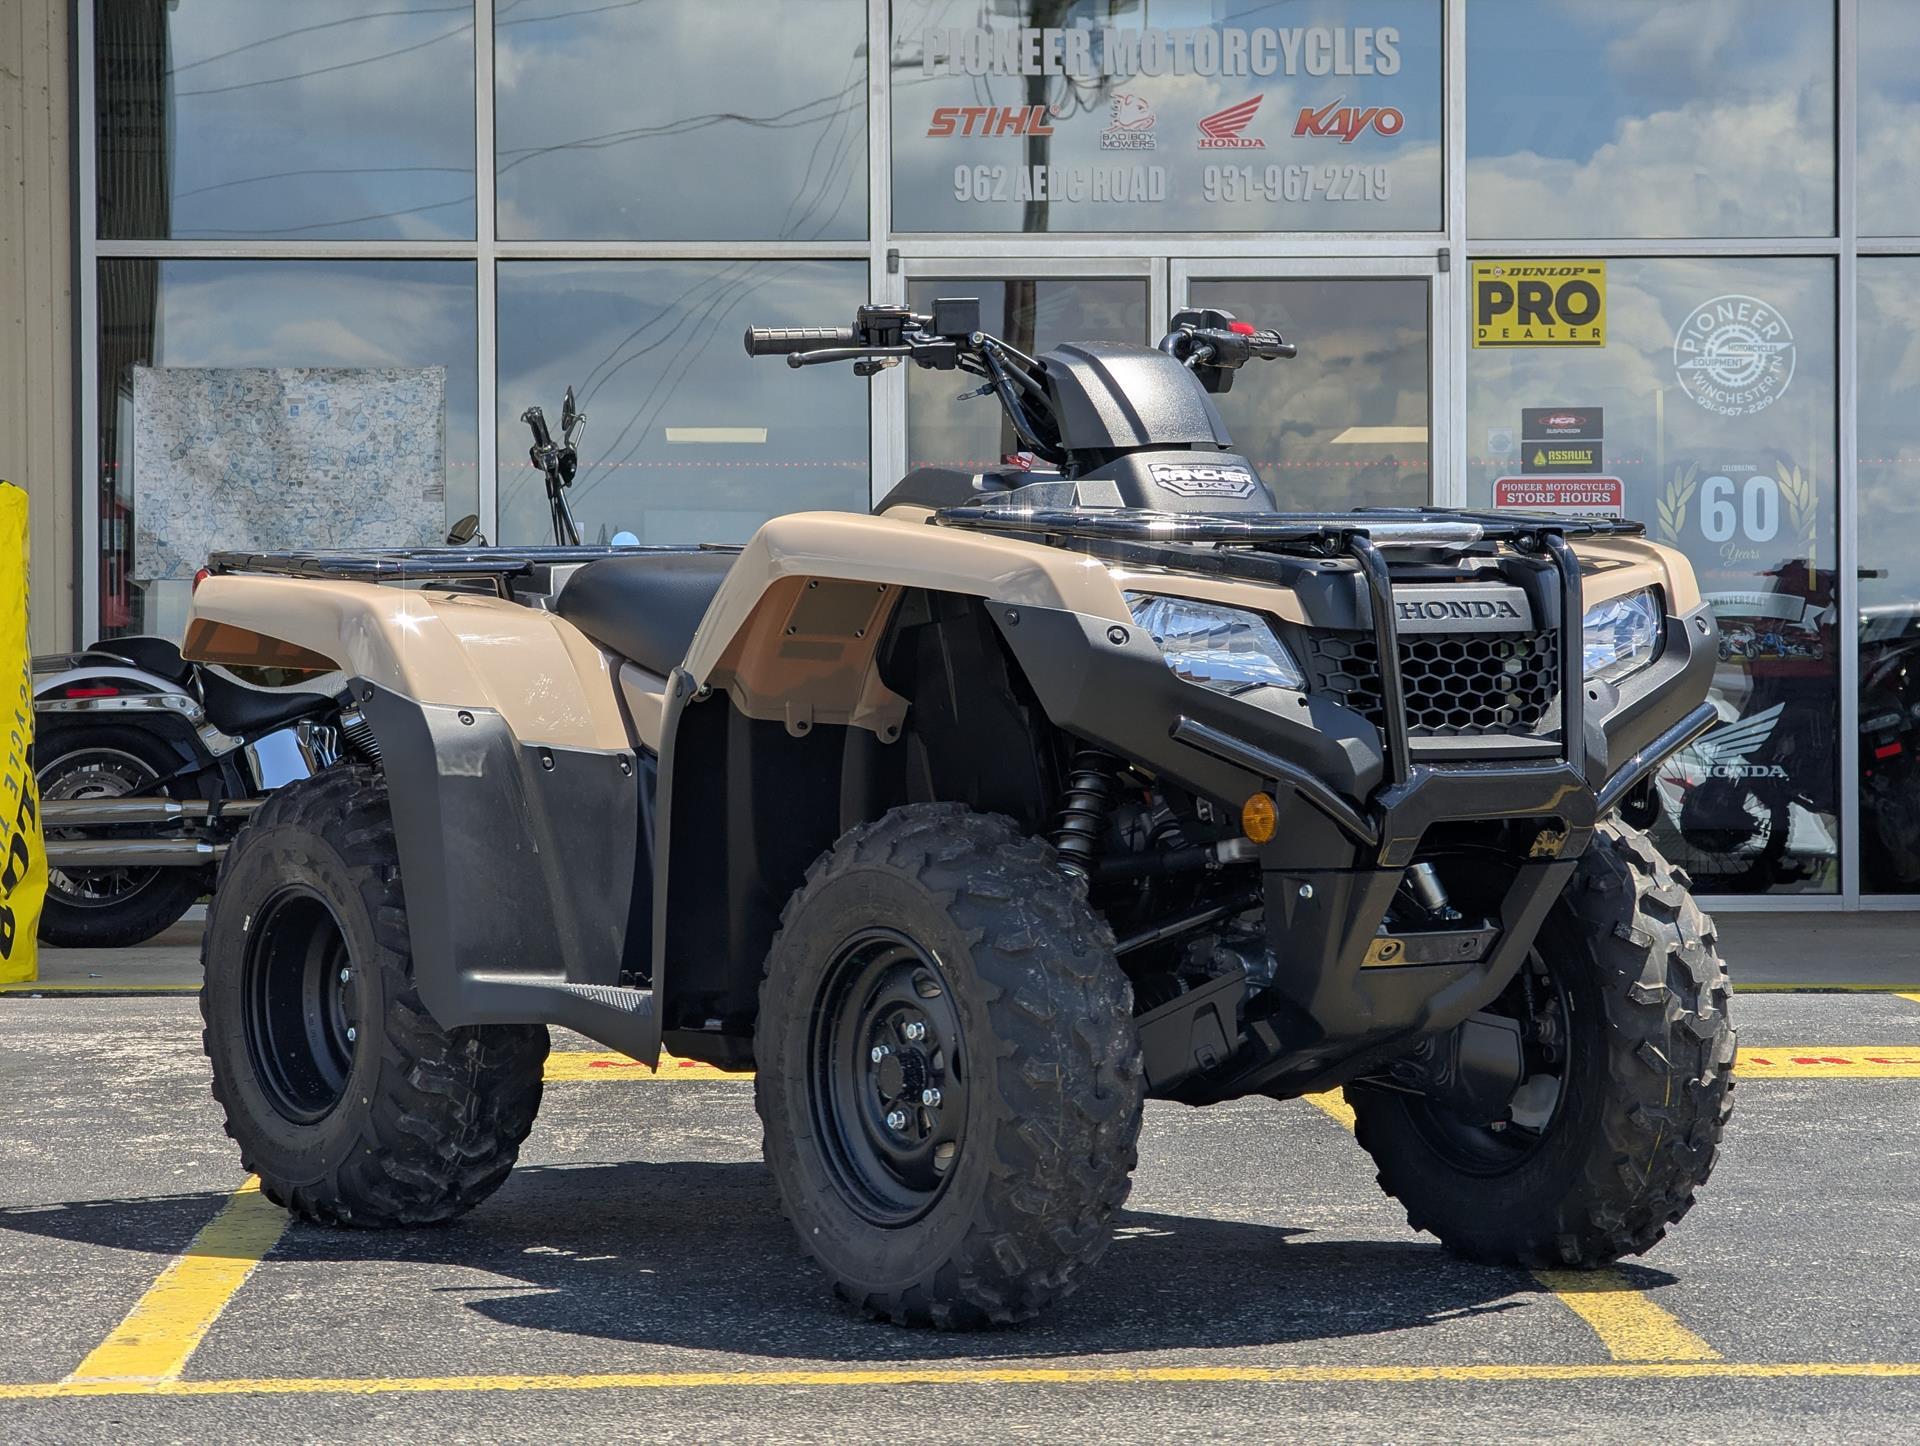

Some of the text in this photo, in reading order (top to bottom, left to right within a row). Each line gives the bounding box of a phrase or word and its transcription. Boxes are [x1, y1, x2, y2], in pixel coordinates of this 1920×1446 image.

[922, 26, 1400, 77] PIONEER MOTORCYCLES
[926, 106, 1055, 137] STIHL
[1292, 96, 1404, 143] KAYO
[1102, 133, 1154, 141] BAD BOY
[1102, 140, 1155, 148] MOWERS
[1199, 138, 1266, 148] HONDA
[953, 164, 1166, 201] 962 AEDC ROAD
[1202, 164, 1393, 201] 931-967-2219
[1507, 267, 1586, 277] DUNLOP
[1478, 279, 1601, 326] PRO
[1478, 327, 1601, 338] DEALER
[1681, 302, 1780, 353] PIONEER
[1692, 358, 1744, 367] EQUIPMENT
[1548, 450, 1593, 460] ASSAULT
[1152, 469, 1254, 484] RANCHER
[1501, 483, 1617, 492] PIONEER MOTORCYCLES
[1506, 492, 1611, 503] STORE HOURS
[1700, 475, 1779, 543] 60
[1719, 542, 1761, 567] Years
[1396, 601, 1521, 619] HONDA
[1695, 764, 1788, 778] HONDA
